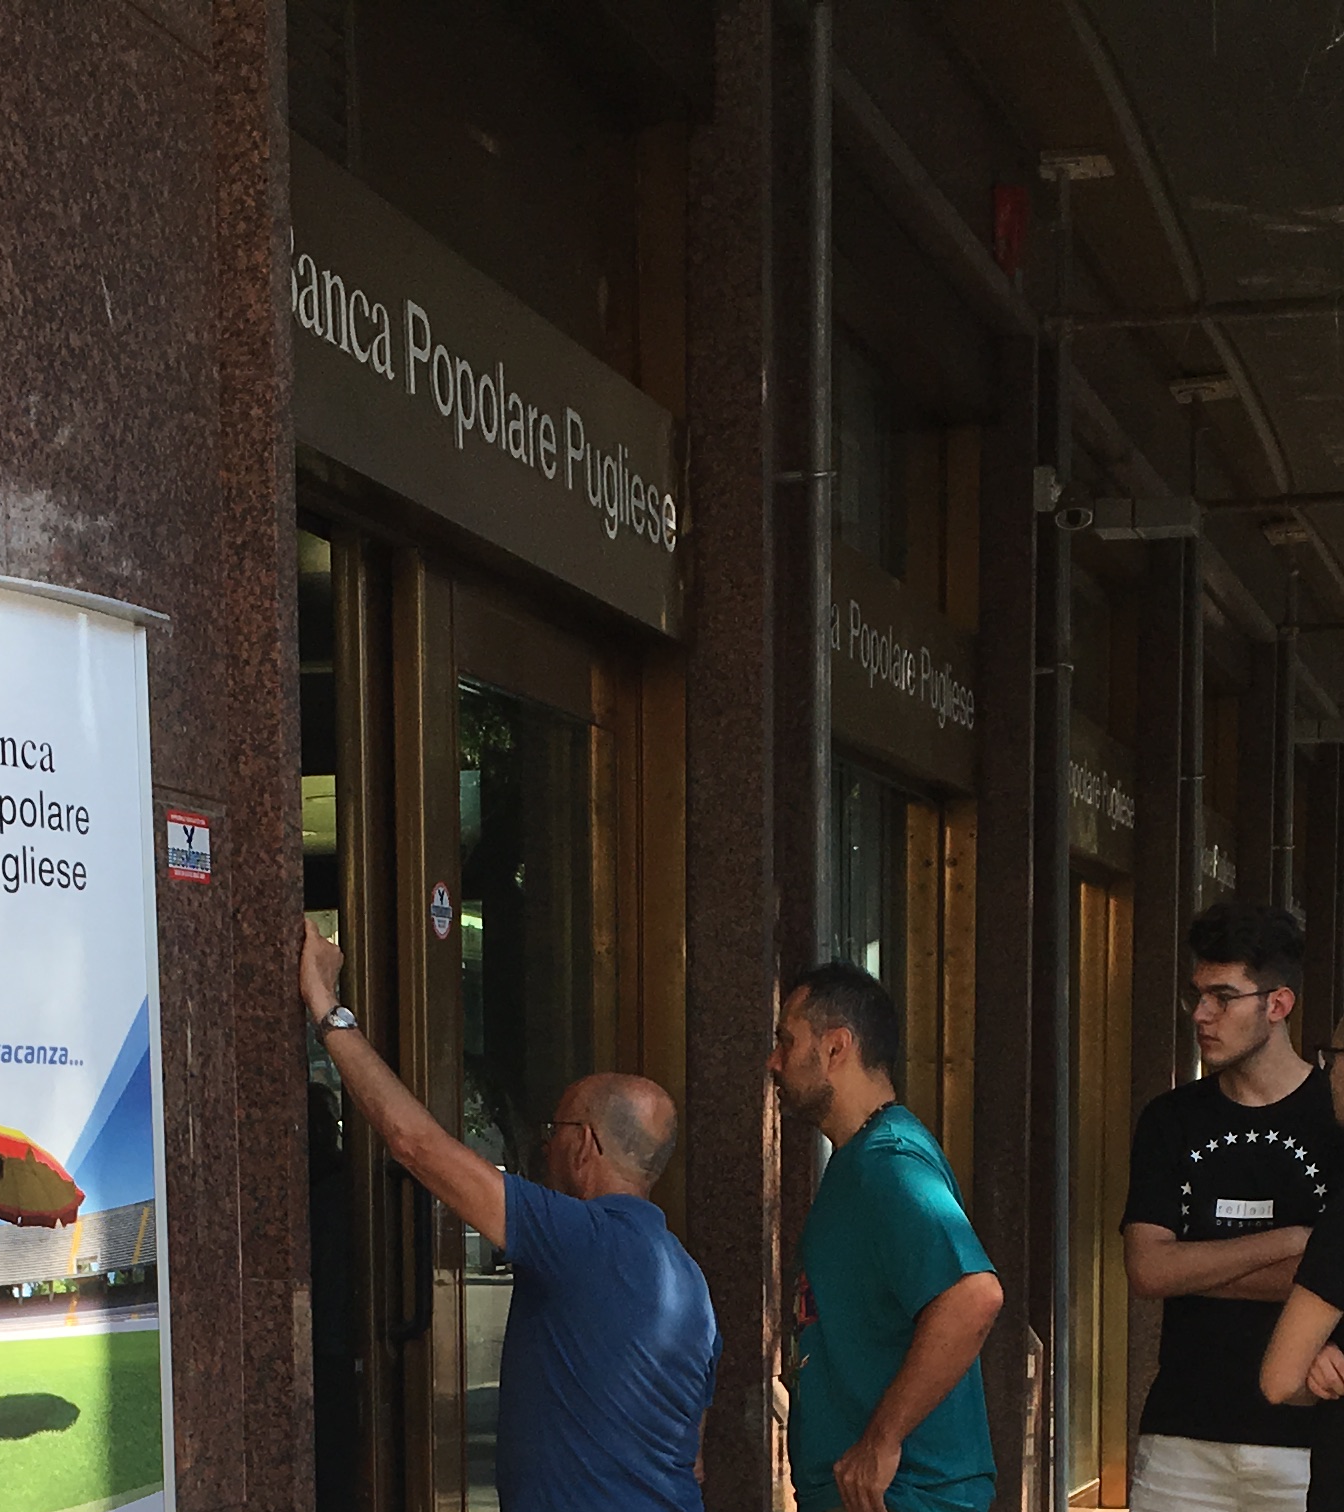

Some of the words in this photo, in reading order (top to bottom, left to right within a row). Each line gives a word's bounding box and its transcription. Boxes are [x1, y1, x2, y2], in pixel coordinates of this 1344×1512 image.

[290, 226, 395, 380] anca
[405, 299, 557, 480] Popolare
[565, 406, 677, 552] Pugliese
[848, 599, 917, 697] Popolare
[919, 646, 976, 731] Pugliese
[1068, 758, 1101, 809] opolare
